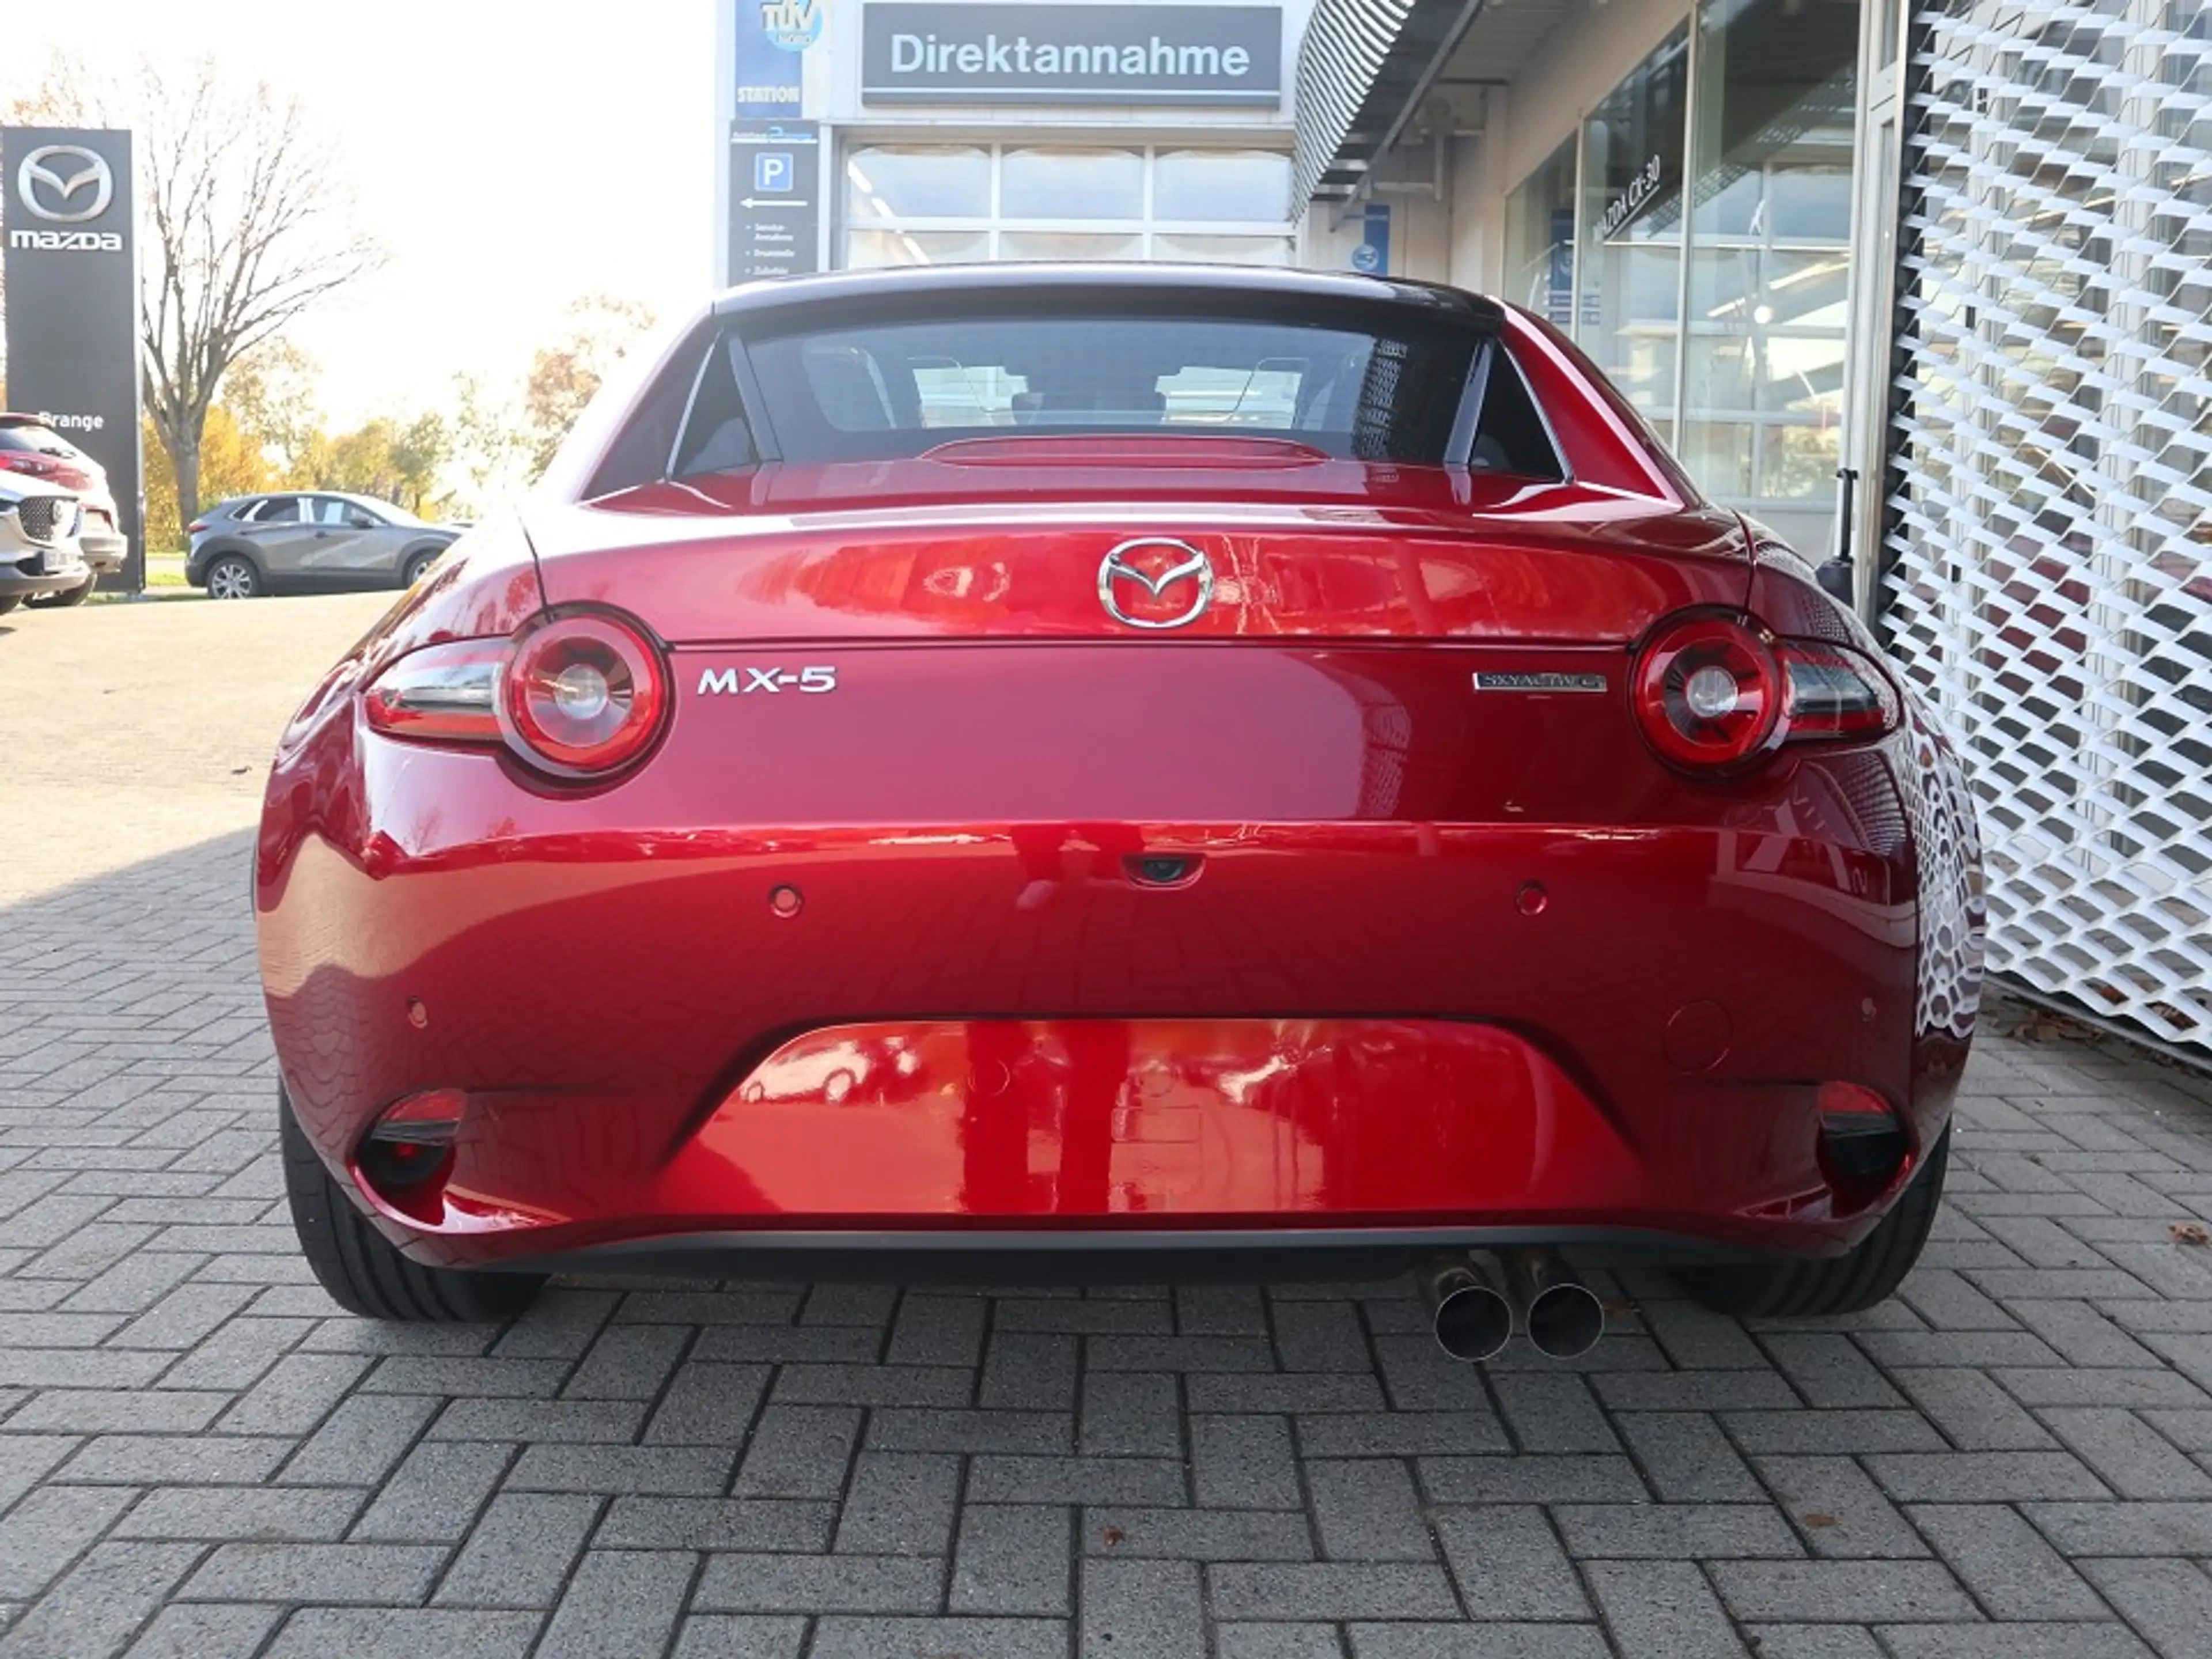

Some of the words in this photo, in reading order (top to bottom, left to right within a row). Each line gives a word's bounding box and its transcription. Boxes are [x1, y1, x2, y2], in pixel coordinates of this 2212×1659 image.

[891, 34, 1249, 75] Direktannahme
[737, 86, 799, 103] STATION
[764, 159, 783, 185] P
[698, 666, 836, 695] MX-5
